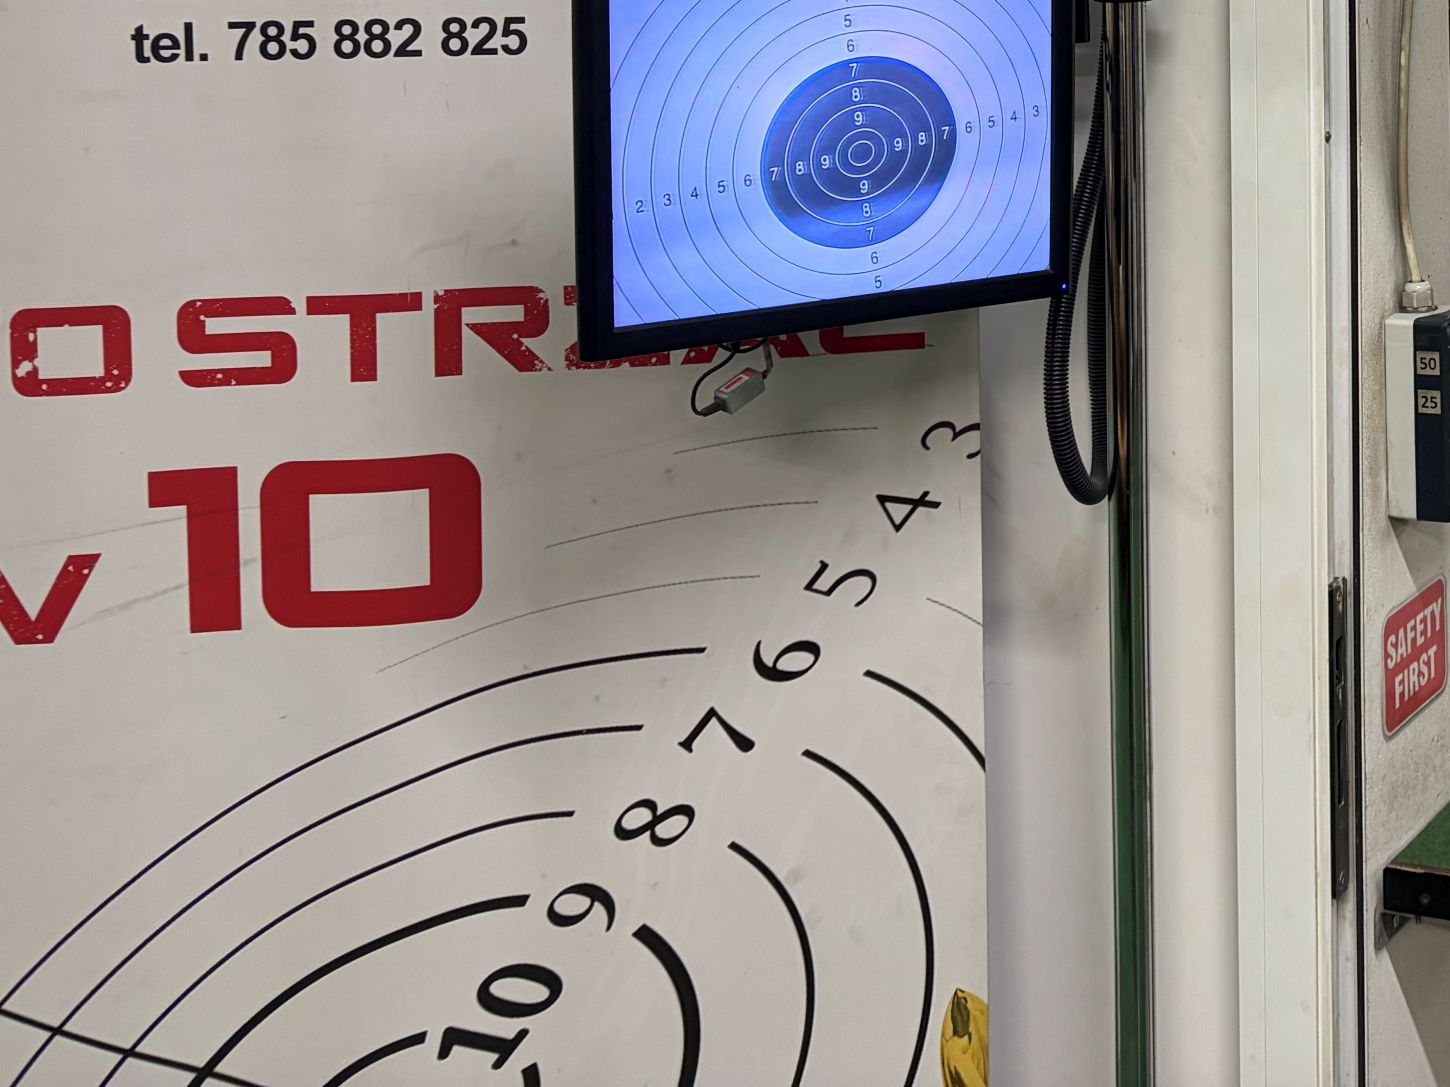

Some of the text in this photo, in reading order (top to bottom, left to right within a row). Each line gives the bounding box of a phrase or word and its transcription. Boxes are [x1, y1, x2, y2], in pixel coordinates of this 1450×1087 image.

[844, 14, 852, 28] 5
[130, 17, 528, 64] tel. 785 882 825
[846, 39, 855, 53] 6
[849, 63, 858, 77] 7
[851, 87, 860, 101] 8
[854, 112, 862, 125] 9
[635, 105, 1040, 213] 2 3 4 5 6 7 8 9 9 8 7 6 5 4 3
[859, 180, 868, 194] 9
[862, 203, 871, 217] 8
[866, 227, 875, 240] 7
[870, 251, 879, 264] 6
[874, 275, 882, 289] 5
[1419, 356, 1437, 371] 50
[1420, 395, 1438, 409] 25
[148, 452, 483, 635] 10
[1386, 597, 1442, 670] SAFETY
[1394, 644, 1438, 710] FIRST
[437, 963, 563, 1070] 10
[546, 882, 617, 932] 9
[613, 798, 696, 847] 8
[678, 707, 756, 754] 7
[752, 638, 821, 683] 6
[804, 560, 877, 607] 5
[875, 488, 942, 532] 4
